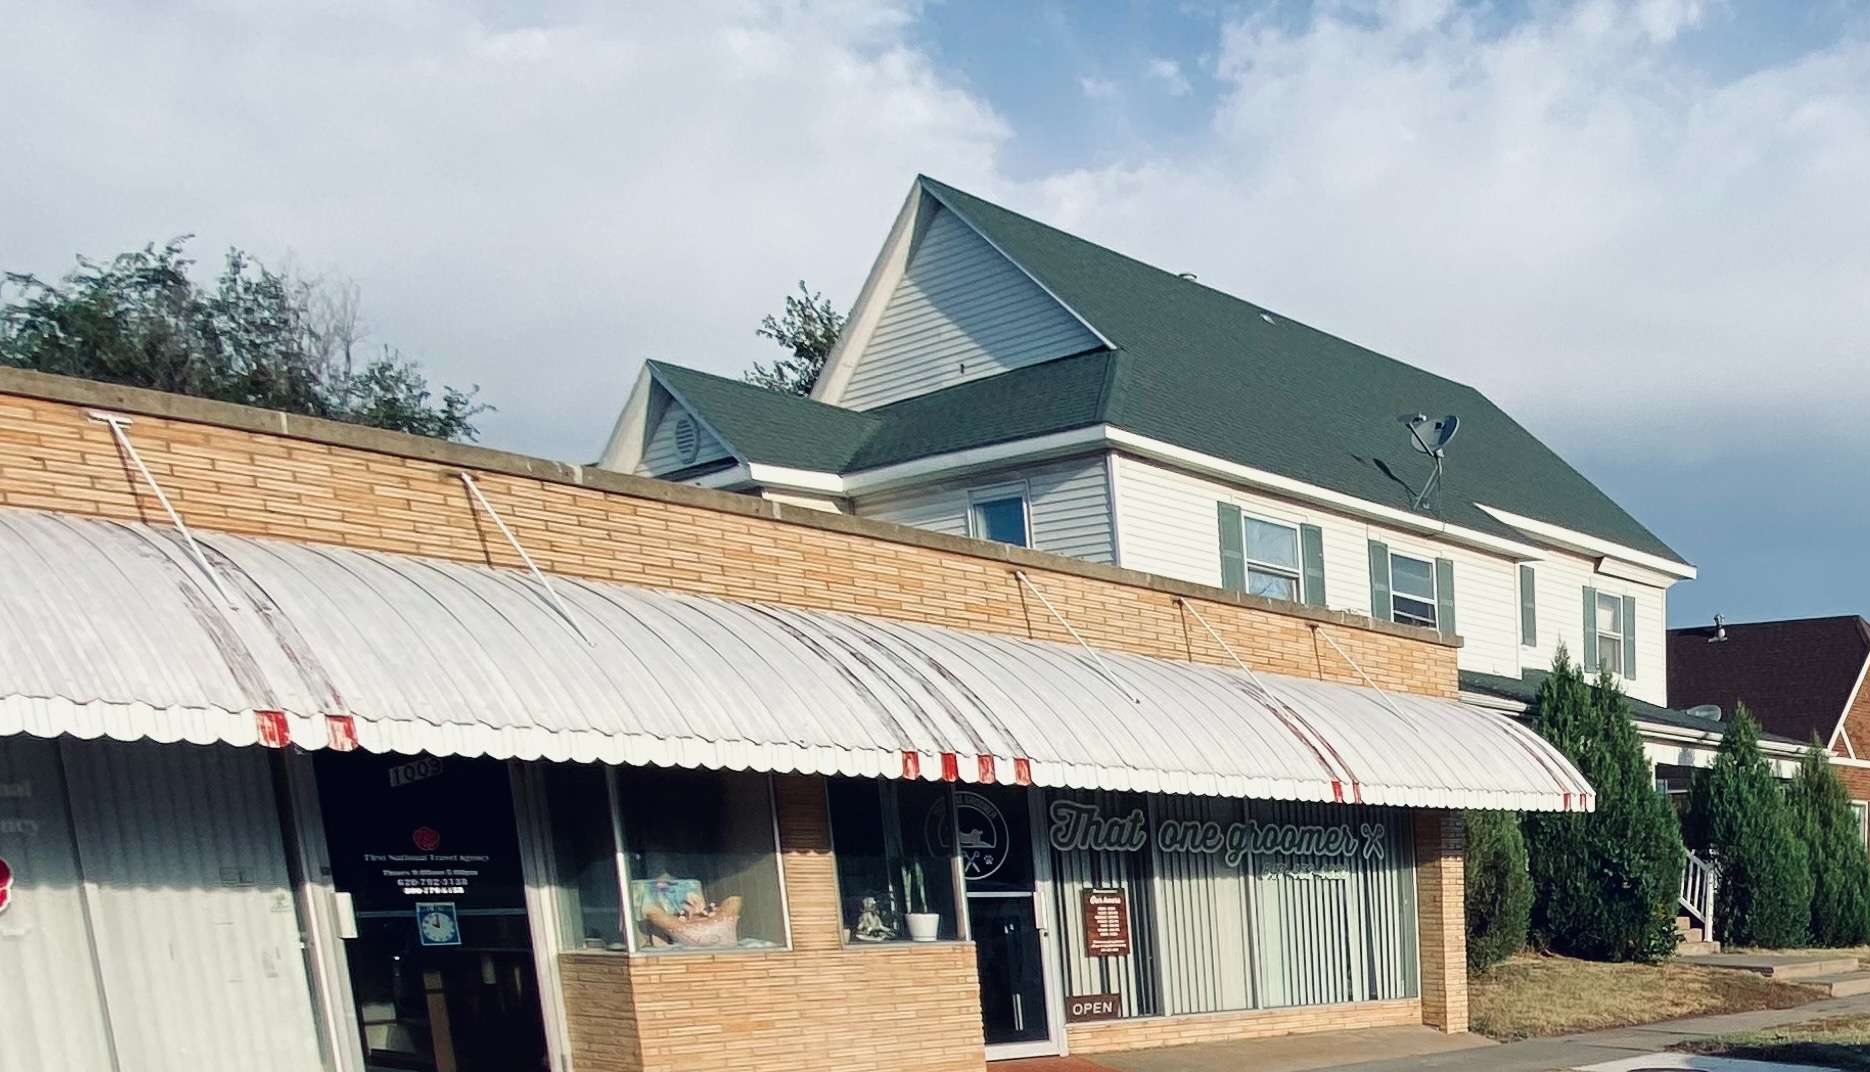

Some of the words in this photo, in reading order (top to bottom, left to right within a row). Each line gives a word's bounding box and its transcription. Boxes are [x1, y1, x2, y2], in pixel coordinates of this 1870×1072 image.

[1050, 800, 1147, 851] That
[1158, 821, 1224, 852] one
[1225, 819, 1358, 867] groomer
[1072, 1001, 1112, 1015] OPEN
